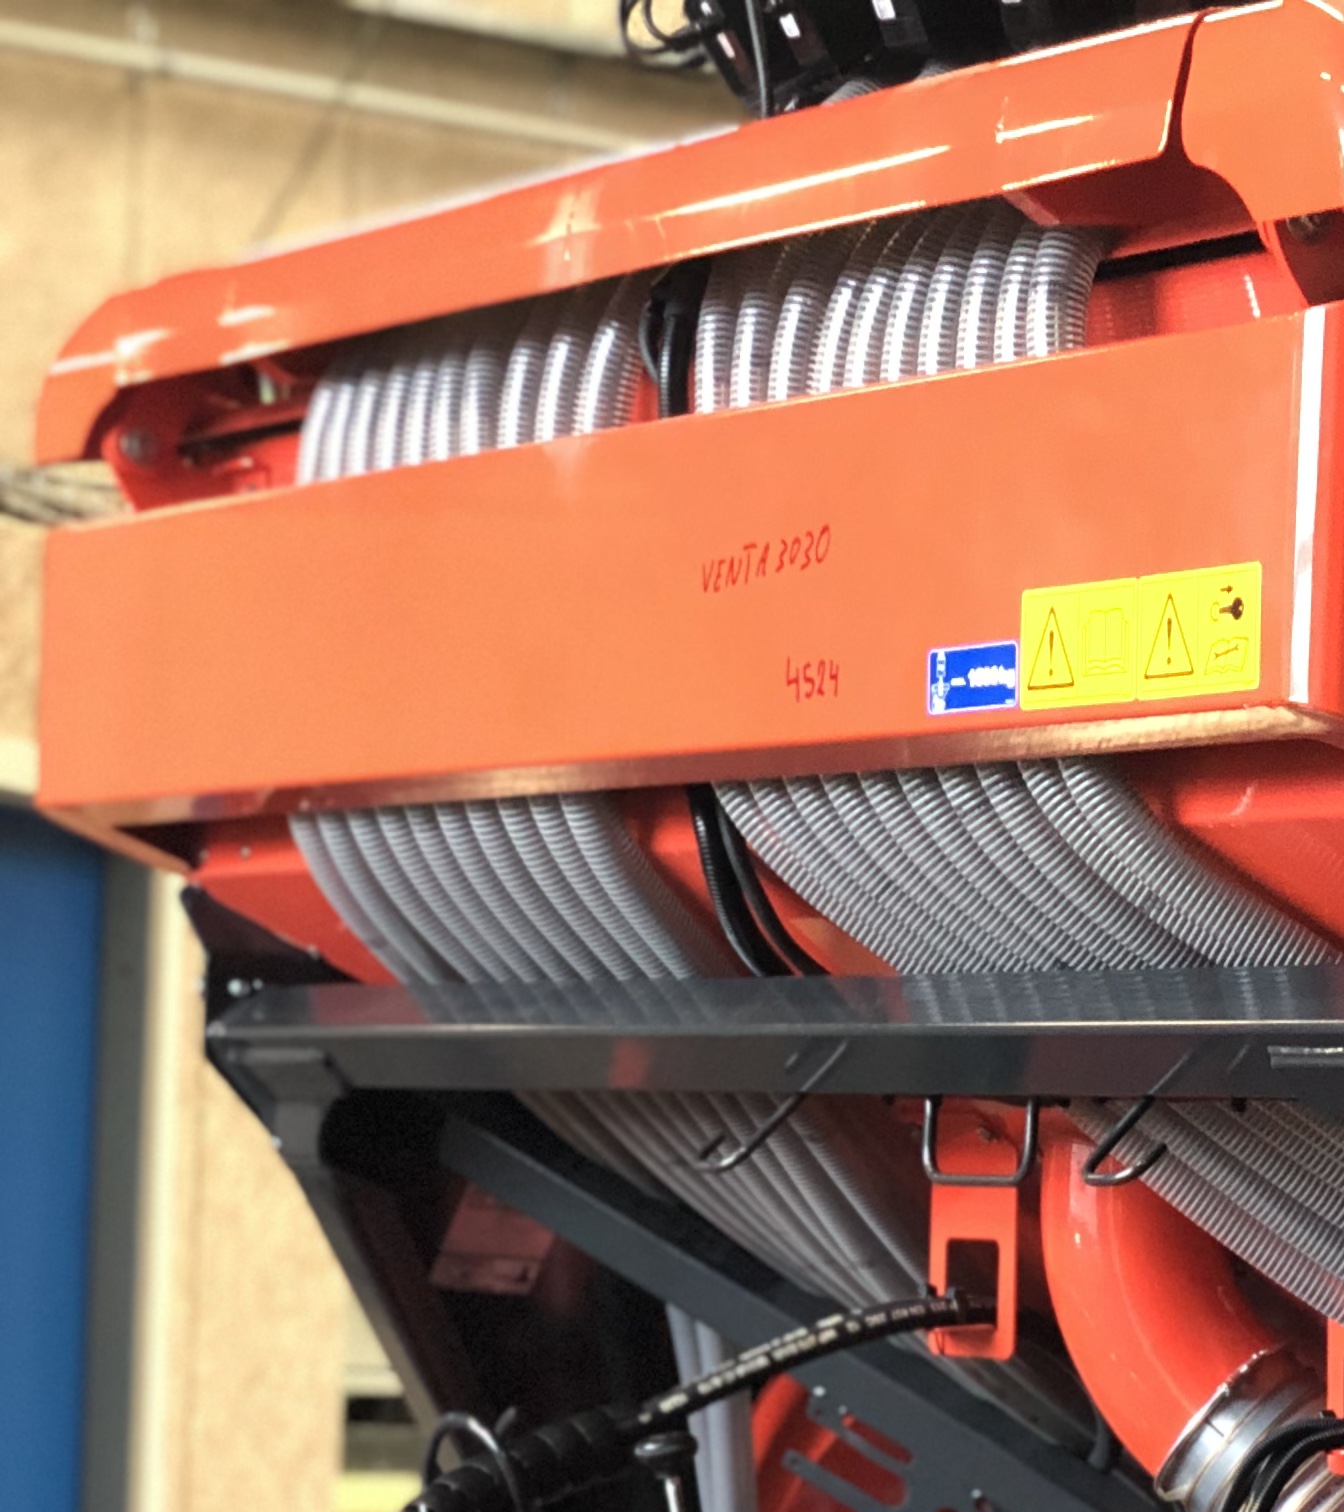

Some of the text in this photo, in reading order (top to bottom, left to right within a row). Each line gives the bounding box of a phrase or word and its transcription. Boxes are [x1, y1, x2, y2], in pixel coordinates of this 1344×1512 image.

[702, 523, 831, 593] VENTA 3030
[786, 656, 840, 703] 4524
